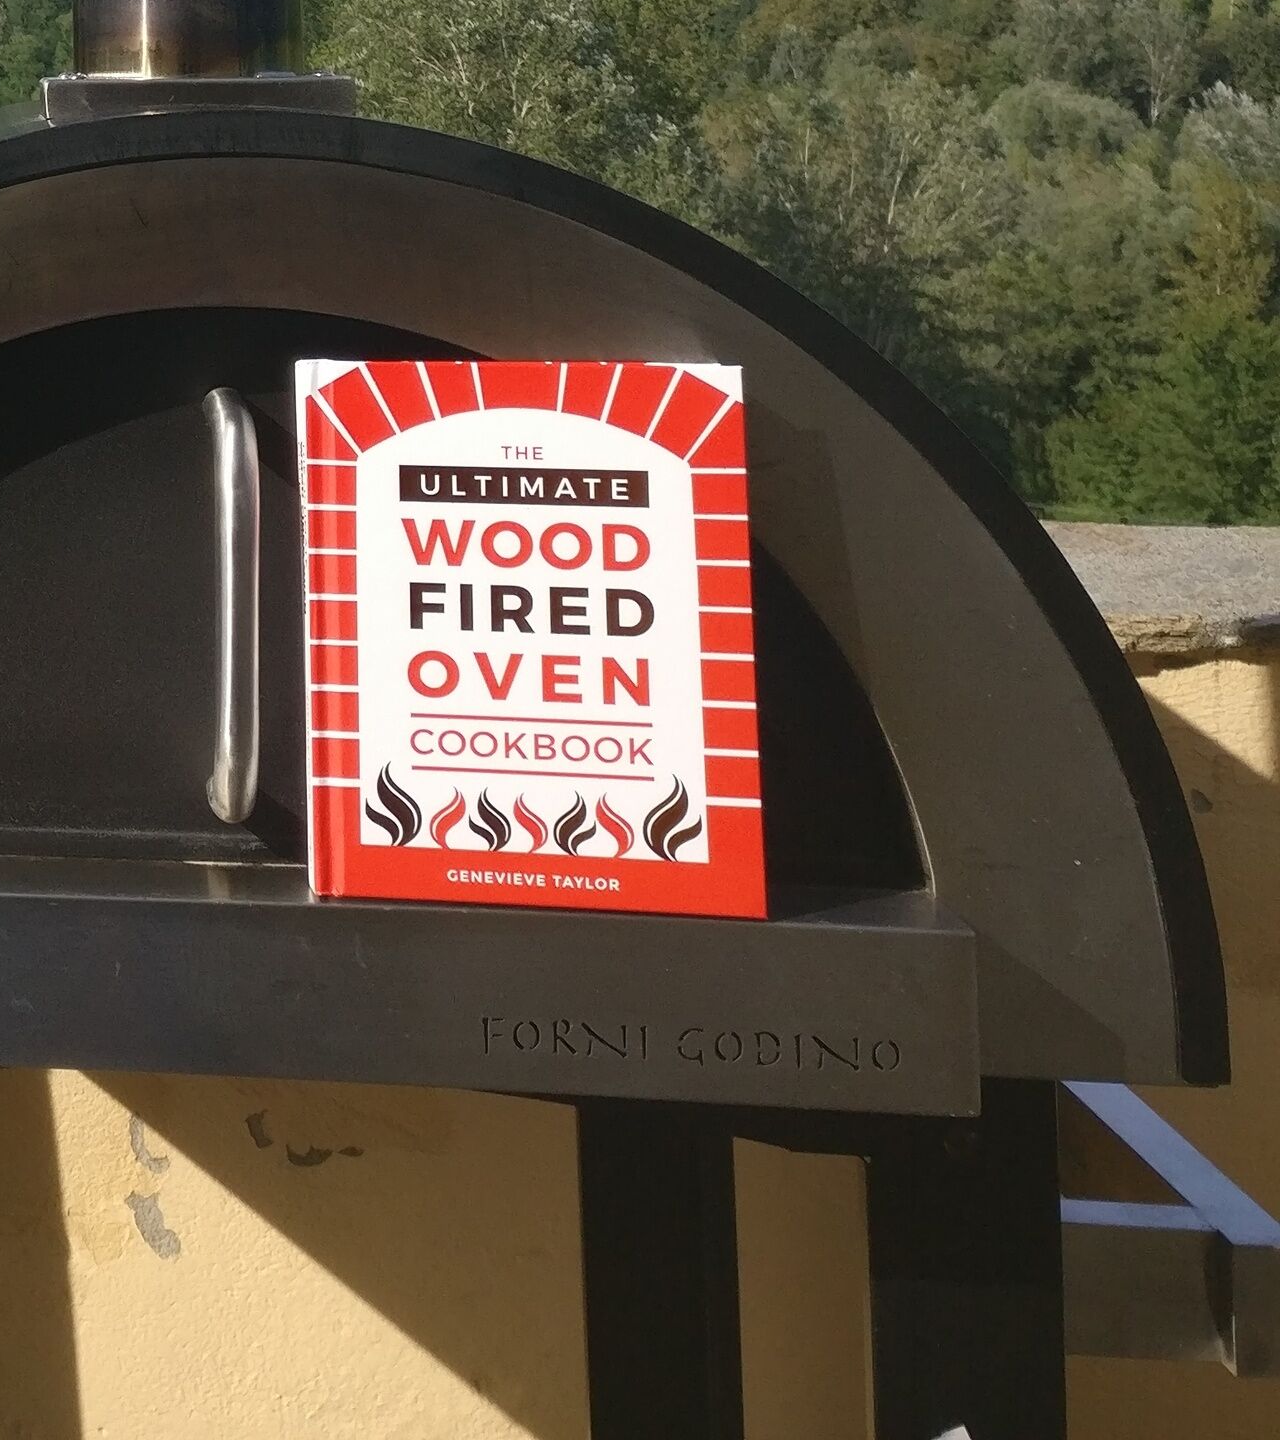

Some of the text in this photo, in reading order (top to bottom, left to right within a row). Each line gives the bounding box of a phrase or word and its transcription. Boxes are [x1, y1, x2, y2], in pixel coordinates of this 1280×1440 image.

[501, 445, 544, 461] THE
[420, 474, 630, 500] ULTIMATE
[401, 518, 651, 571] WOOD
[409, 582, 655, 636] FIRED
[407, 650, 650, 706] OVEN
[410, 728, 654, 766] COOKBOOK
[446, 869, 620, 891] GENEVIEVE TAYLOR
[481, 1017, 902, 1071] FORNI GODINO
